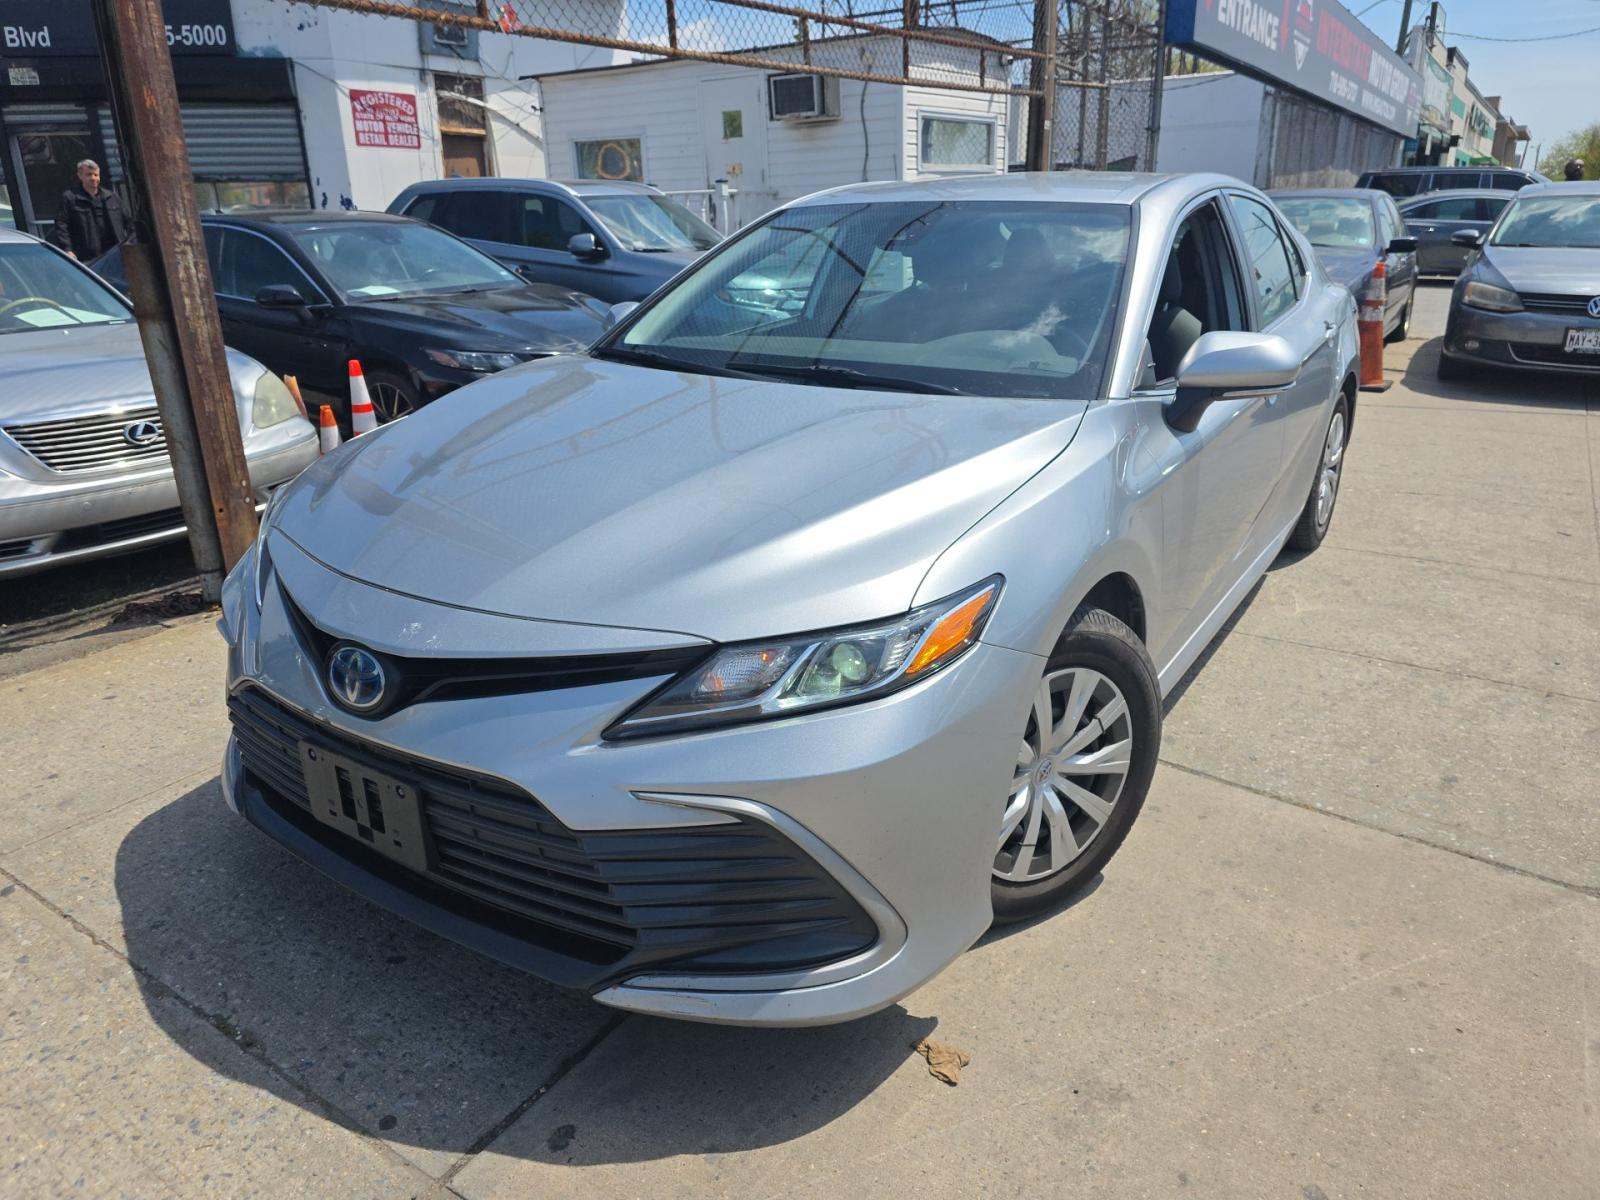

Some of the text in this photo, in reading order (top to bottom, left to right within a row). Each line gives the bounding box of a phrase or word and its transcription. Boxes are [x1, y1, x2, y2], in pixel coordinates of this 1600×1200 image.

[1218, 0, 1280, 51] ENTRANCE
[4, 26, 51, 48] Blvd
[353, 93, 415, 116] REGISTERED
[355, 119, 418, 135] MOTOR VEHICLE
[358, 132, 419, 147] RETAIL DEALER
